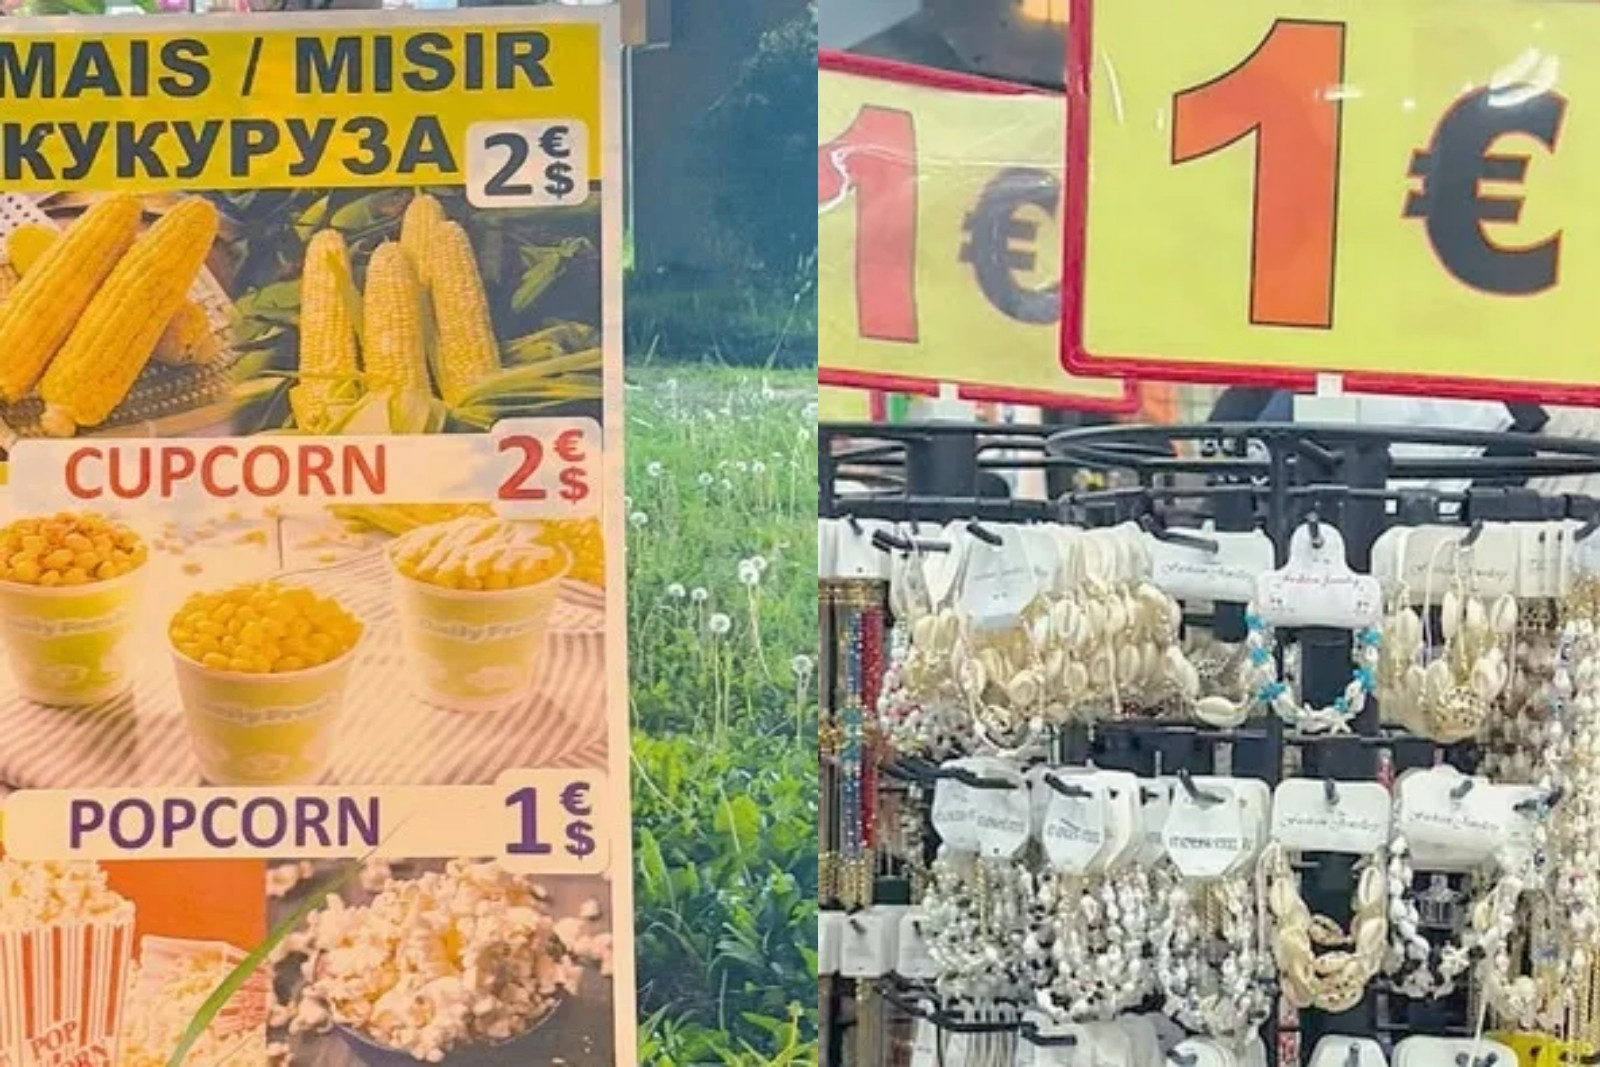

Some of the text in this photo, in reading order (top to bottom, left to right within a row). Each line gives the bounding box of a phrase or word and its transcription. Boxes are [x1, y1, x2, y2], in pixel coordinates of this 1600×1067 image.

[0, 31, 553, 98] MAIS / MISIR
[4, 115, 458, 180] КУКУРУЗА
[484, 132, 532, 196] 2
[1171, 18, 1568, 330] 1 €
[818, 104, 919, 342] 1
[65, 444, 386, 499] CUPCORN
[498, 435, 546, 500] 2
[69, 796, 380, 849] POPCORN
[505, 787, 552, 854] 1
[30, 1020, 77, 1061] POP
